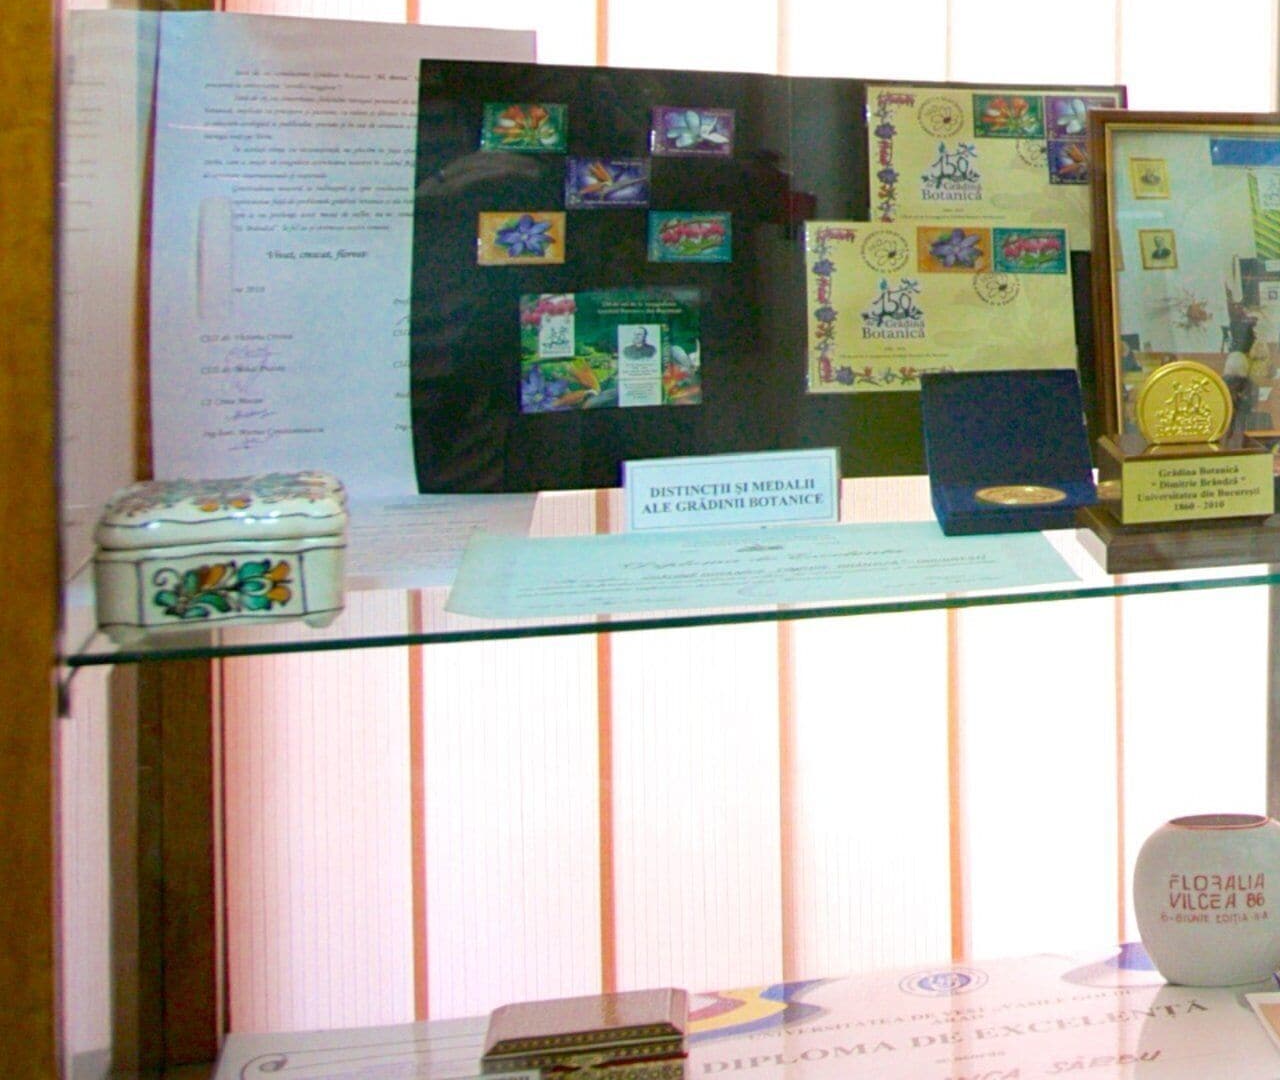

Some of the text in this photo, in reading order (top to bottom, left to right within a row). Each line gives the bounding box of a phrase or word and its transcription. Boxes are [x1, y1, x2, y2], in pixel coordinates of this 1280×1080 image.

[752, 478, 816, 492] MEDALII
[642, 492, 825, 514] ALE GRĂDINII BOTANICE
[1168, 872, 1265, 891] FLORALIA
[1169, 892, 1266, 910] VILCEA 86
[703, 1040, 897, 1074] DIPLOMA
[911, 1032, 963, 1049] DE
